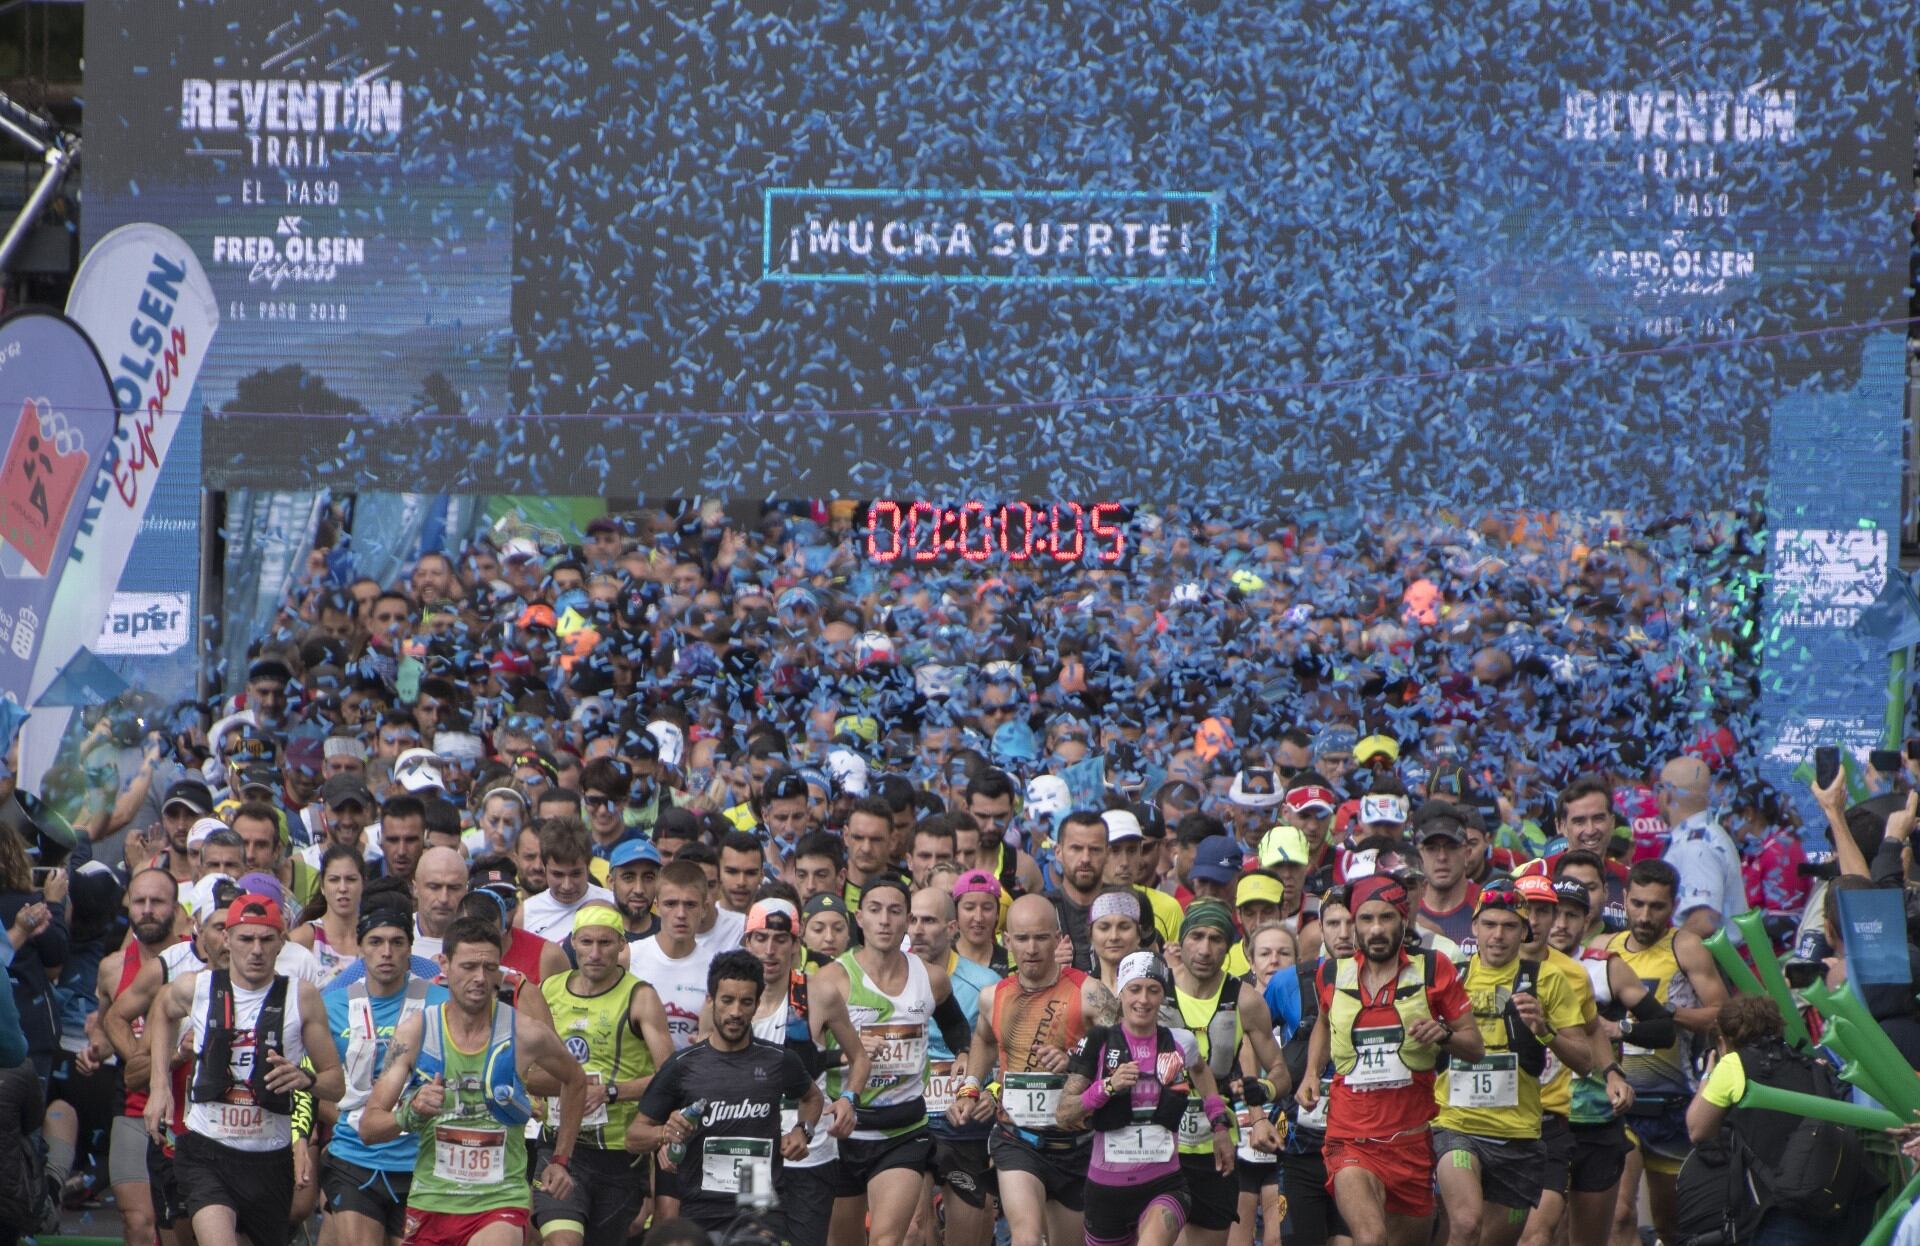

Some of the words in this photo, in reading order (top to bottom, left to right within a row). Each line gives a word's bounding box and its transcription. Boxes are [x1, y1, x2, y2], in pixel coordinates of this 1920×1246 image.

[251, 135, 329, 168] TRAIL
[243, 179, 266, 204] EL
[287, 179, 339, 205] PASO
[286, 237, 364, 265] OLSEN
[114, 252, 187, 416] OLSEN
[867, 501, 1125, 561] 00:00:05
[1363, 1047, 1385, 1068] 44
[1473, 1073, 1492, 1094] 15
[702, 1098, 770, 1127] Jimbee
[1026, 1092, 1046, 1112] 12
[220, 1105, 262, 1127] 1004
[1136, 1128, 1143, 1149] 1
[449, 1145, 490, 1170] 1136
[733, 1158, 744, 1179] 5
